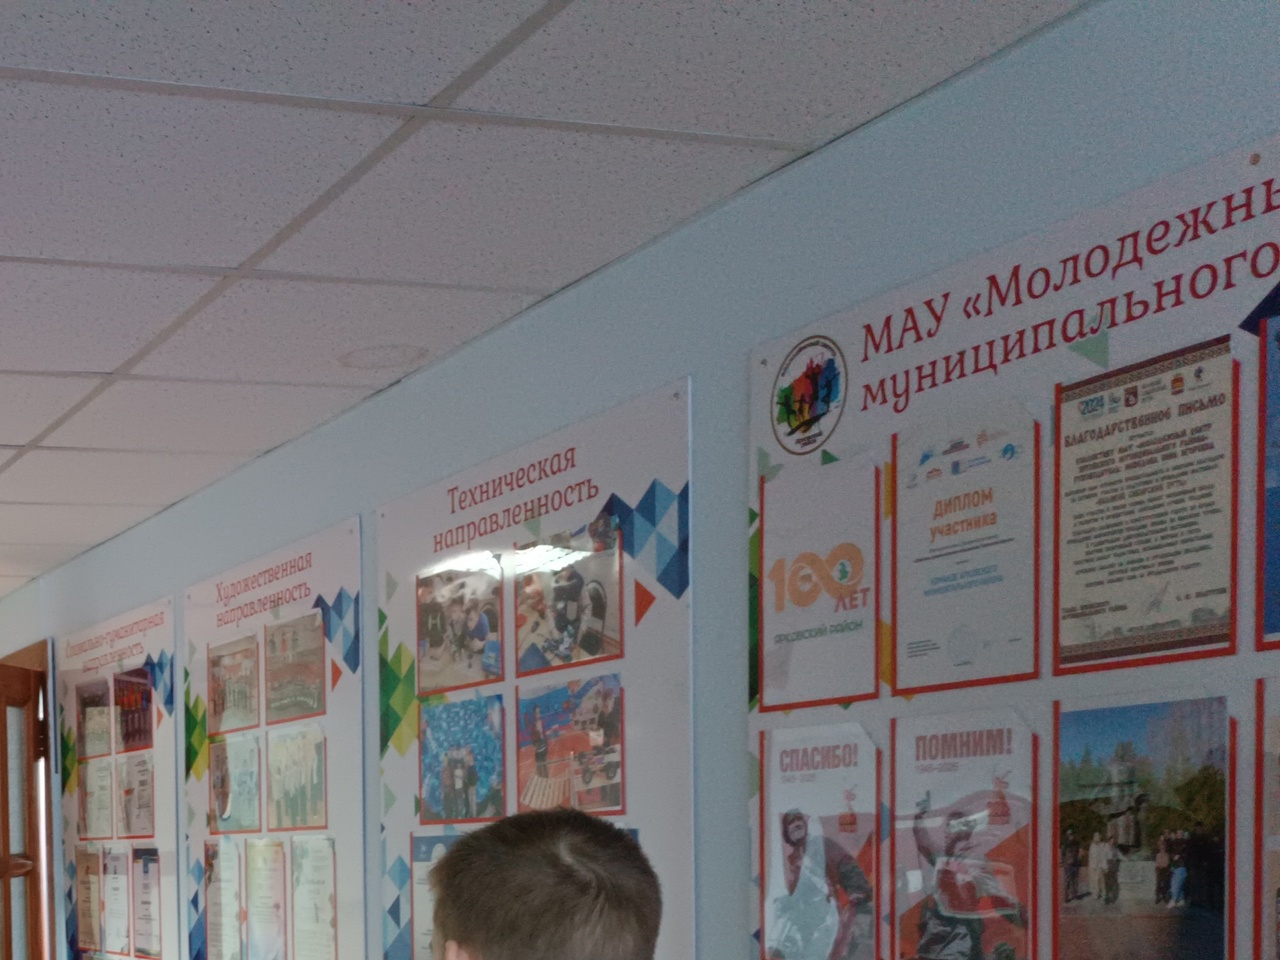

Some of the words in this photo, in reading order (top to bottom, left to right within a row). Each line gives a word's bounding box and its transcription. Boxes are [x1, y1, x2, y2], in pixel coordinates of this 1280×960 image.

[860, 291, 951, 363] МАУ
[860, 242, 1280, 414] муниципального
[446, 446, 576, 514] Техническая
[932, 487, 994, 520] ДИПЛОМ
[432, 477, 599, 553] направленность
[930, 512, 998, 543] участника
[216, 552, 312, 607] Художественная
[768, 542, 865, 614] 100
[833, 586, 871, 614] ЛЕТ
[216, 582, 311, 629] направленность
[780, 743, 858, 772] СПАСИБО!
[915, 728, 1012, 761] ПОМНИМ!
